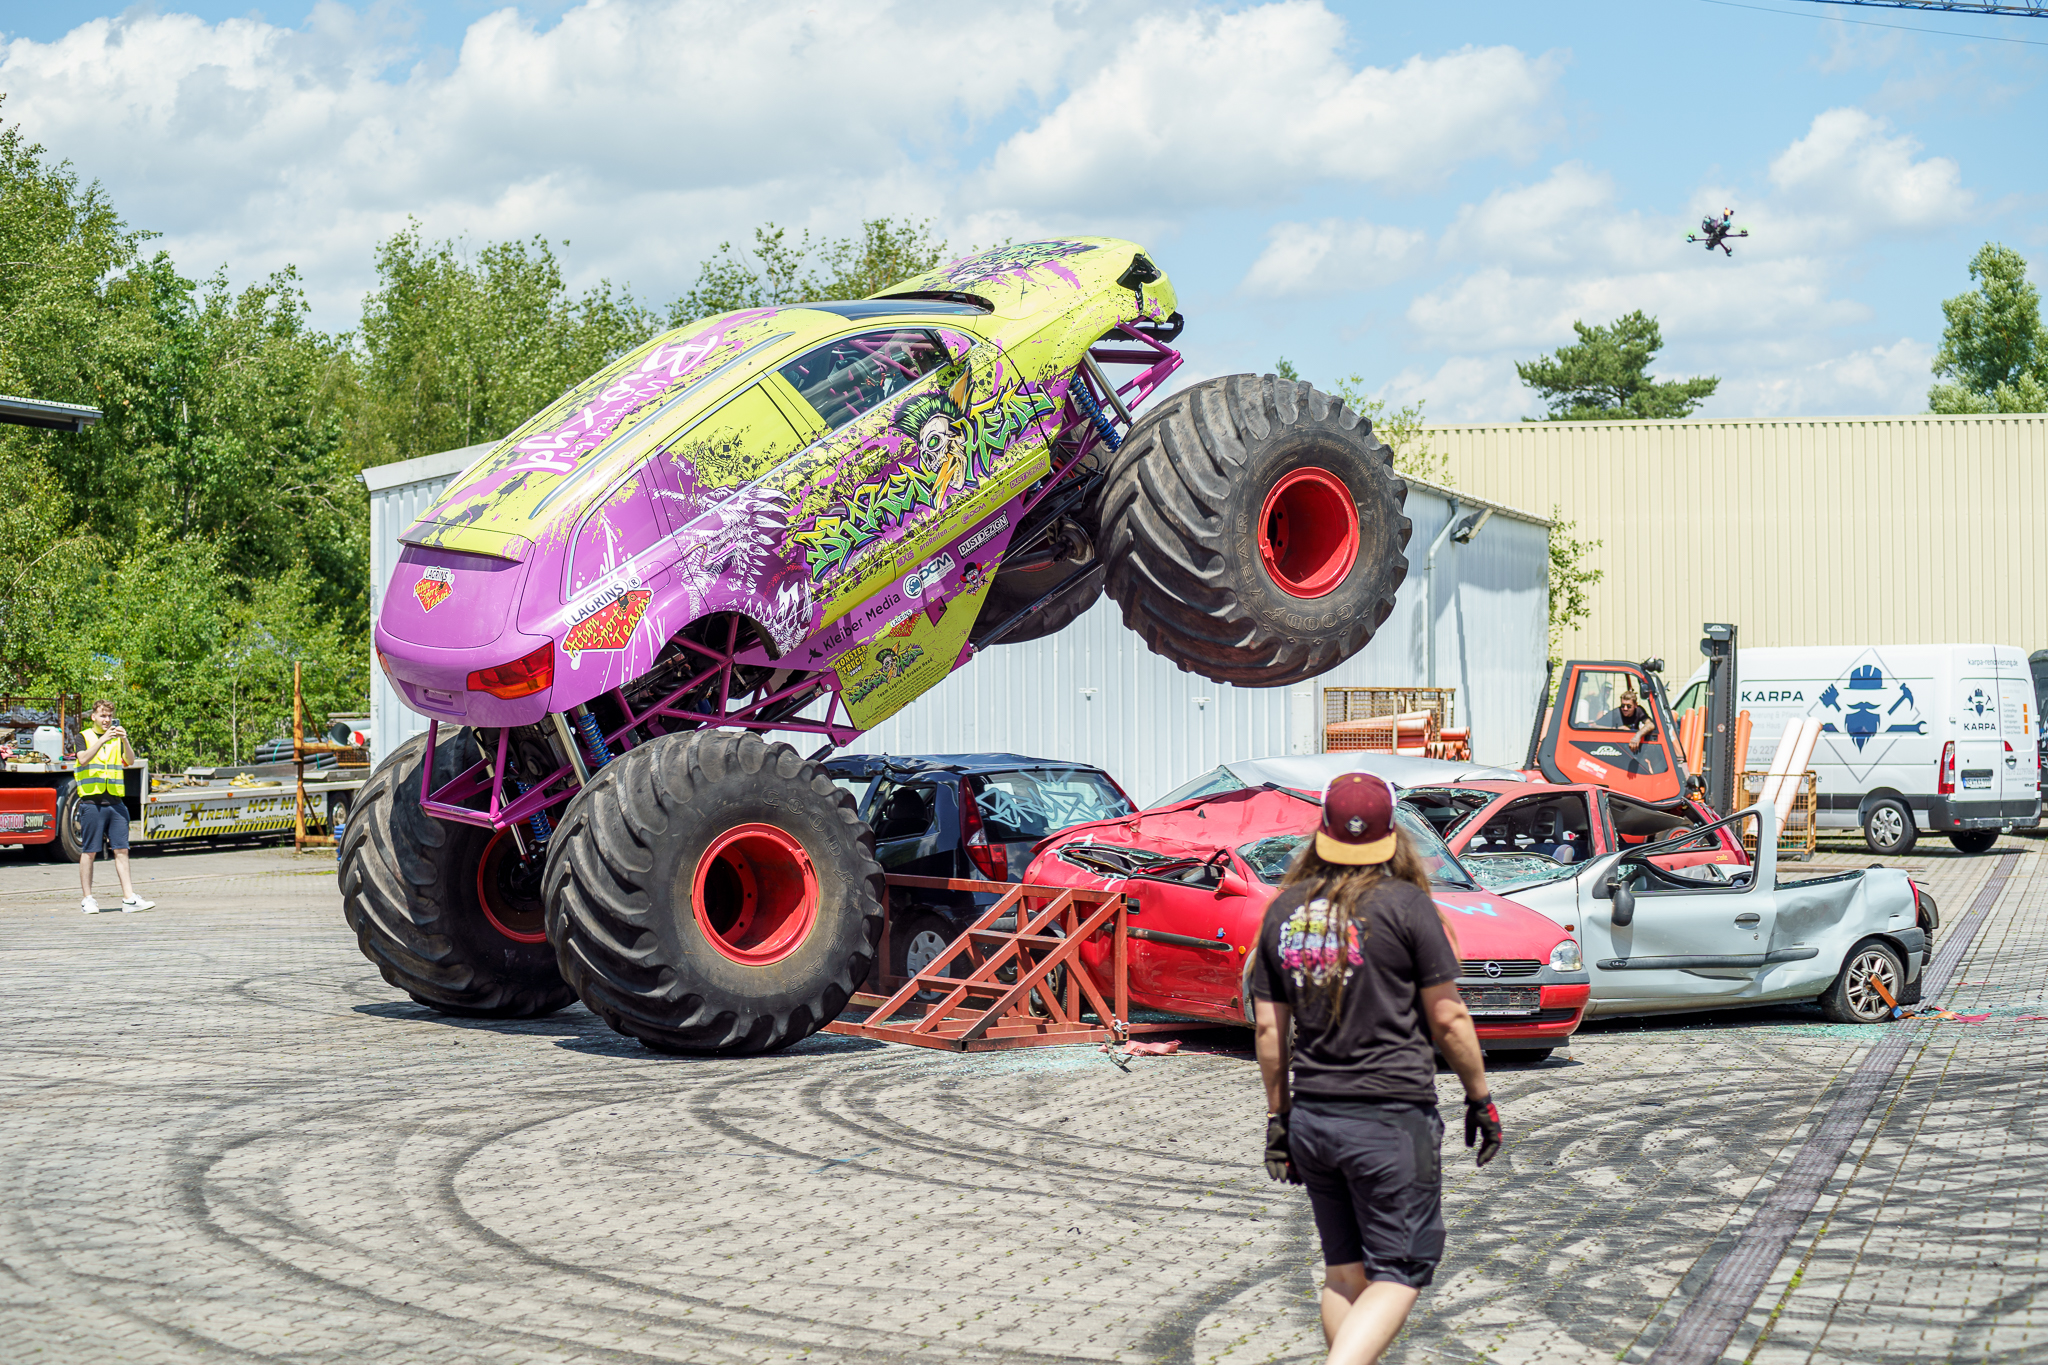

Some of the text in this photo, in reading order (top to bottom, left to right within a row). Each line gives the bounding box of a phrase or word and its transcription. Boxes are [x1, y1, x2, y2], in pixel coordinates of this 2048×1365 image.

[507, 335, 719, 472] Bioxyd
[559, 380, 668, 458] Wrapped by
[793, 377, 1055, 584] BROKEN HEAD
[919, 554, 951, 580] DCM
[1236, 512, 1353, 631] GOODYEAR
[571, 583, 625, 623] LAGRINS
[612, 597, 650, 645] Team
[822, 592, 901, 651] Kleiber Media
[566, 617, 600, 657] Action
[593, 608, 623, 648] Sport
[834, 645, 868, 670] MONSTER
[842, 654, 866, 674] TRUCK
[1741, 691, 1804, 702] KARPA
[1963, 723, 1996, 731] KARPA
[25, 815, 44, 828] SHOW
[183, 802, 241, 828] EXTREME
[247, 794, 322, 813] HOT NIRO
